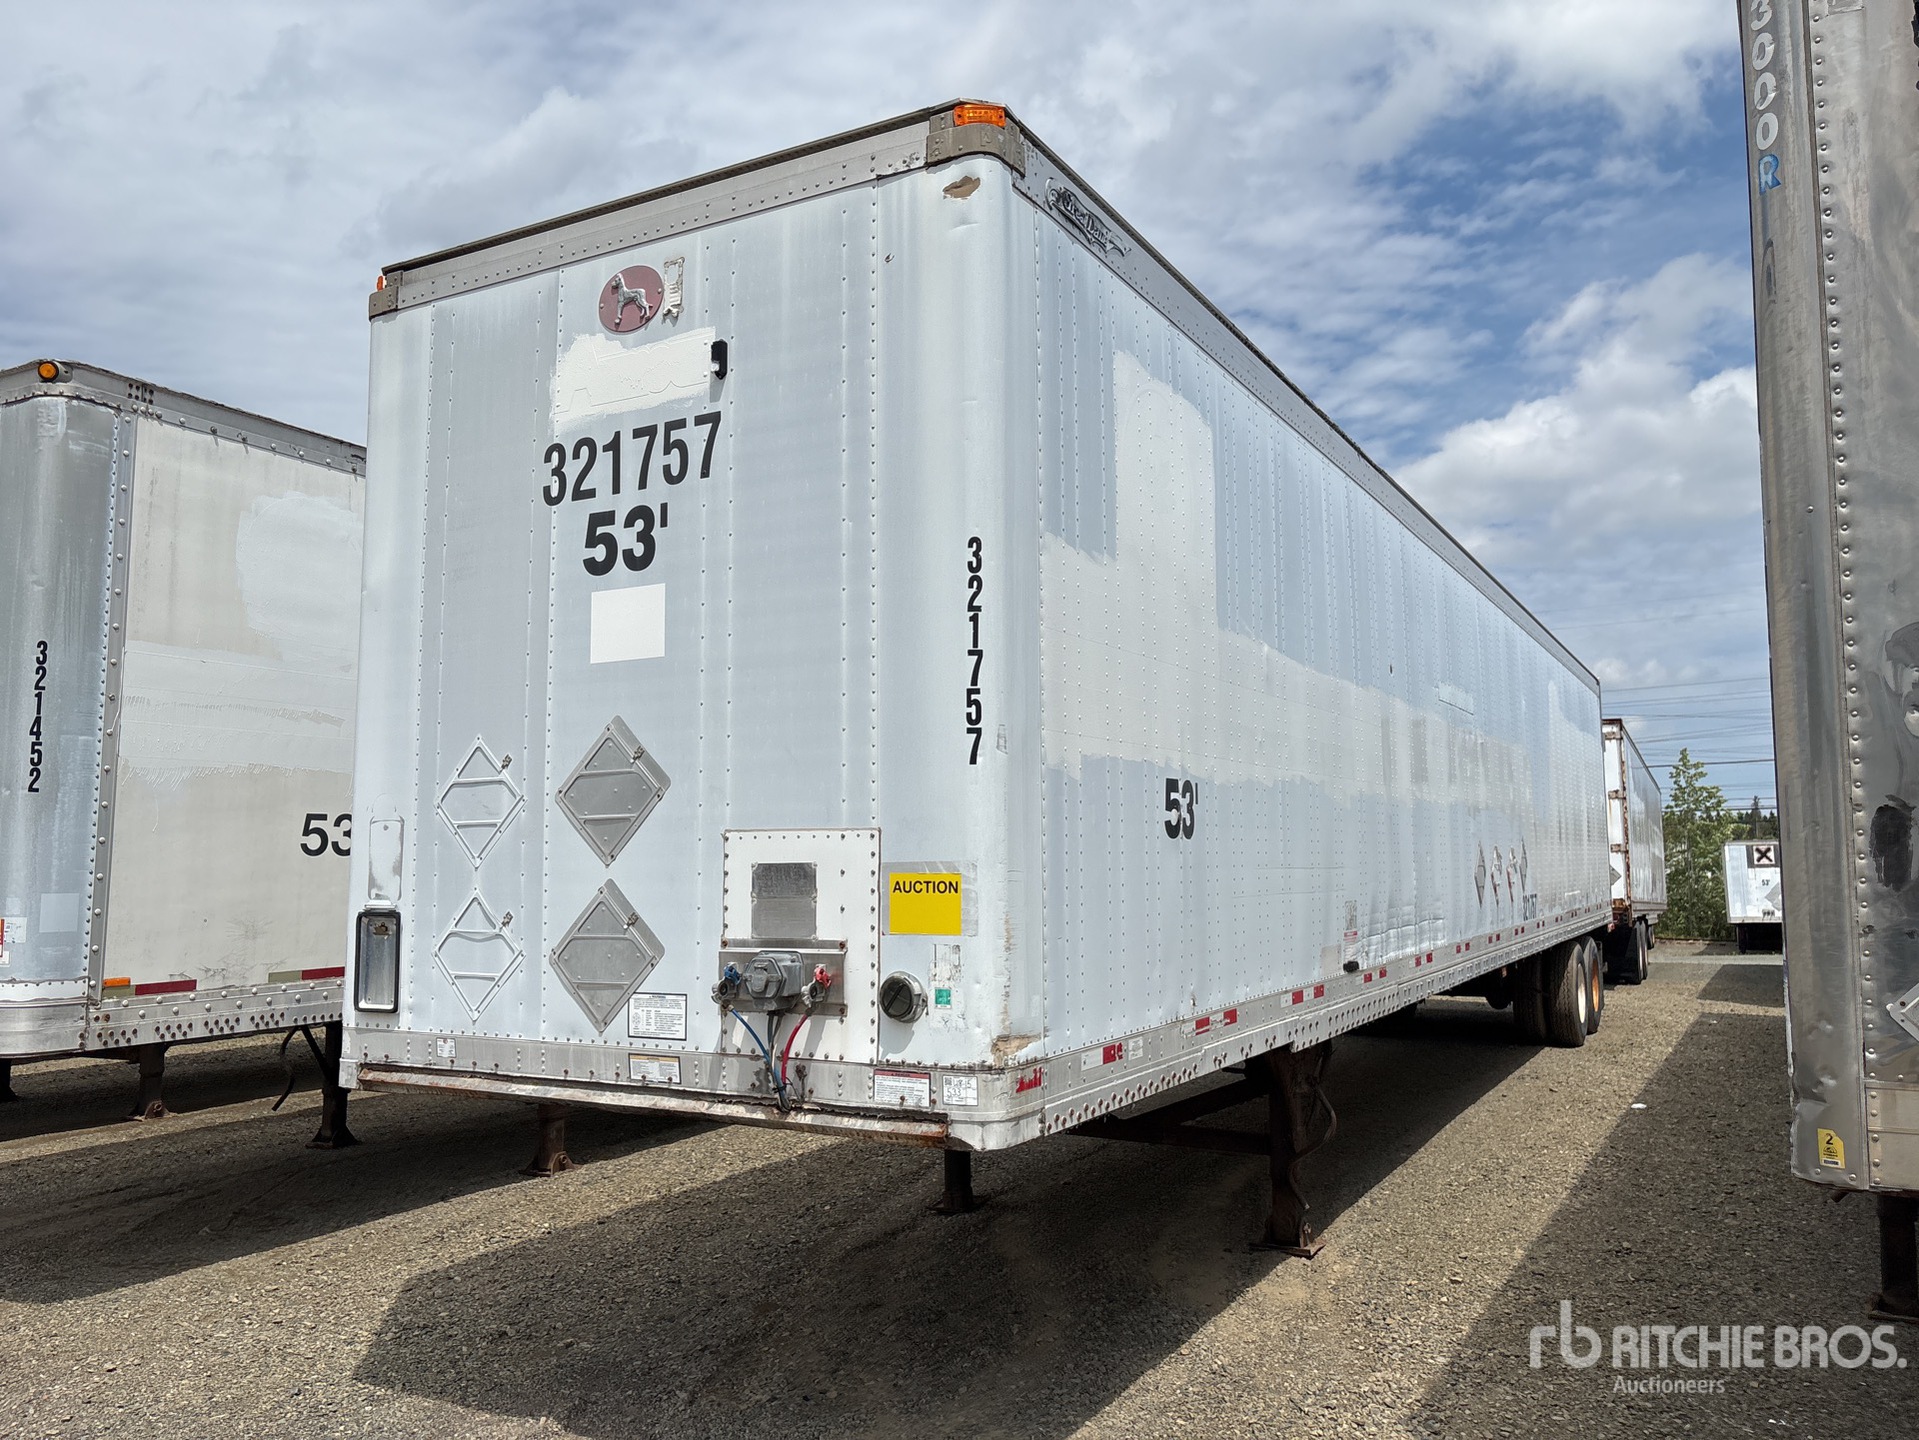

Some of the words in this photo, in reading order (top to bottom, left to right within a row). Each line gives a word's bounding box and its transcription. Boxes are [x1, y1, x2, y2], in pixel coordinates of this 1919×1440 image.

[542, 410, 722, 507] 321757
[582, 502, 669, 577] 53'
[966, 536, 984, 766] 321757
[27, 640, 49, 793] 321452
[892, 880, 959, 894] AUCTION
[1825, 1132, 1834, 1146] 2
